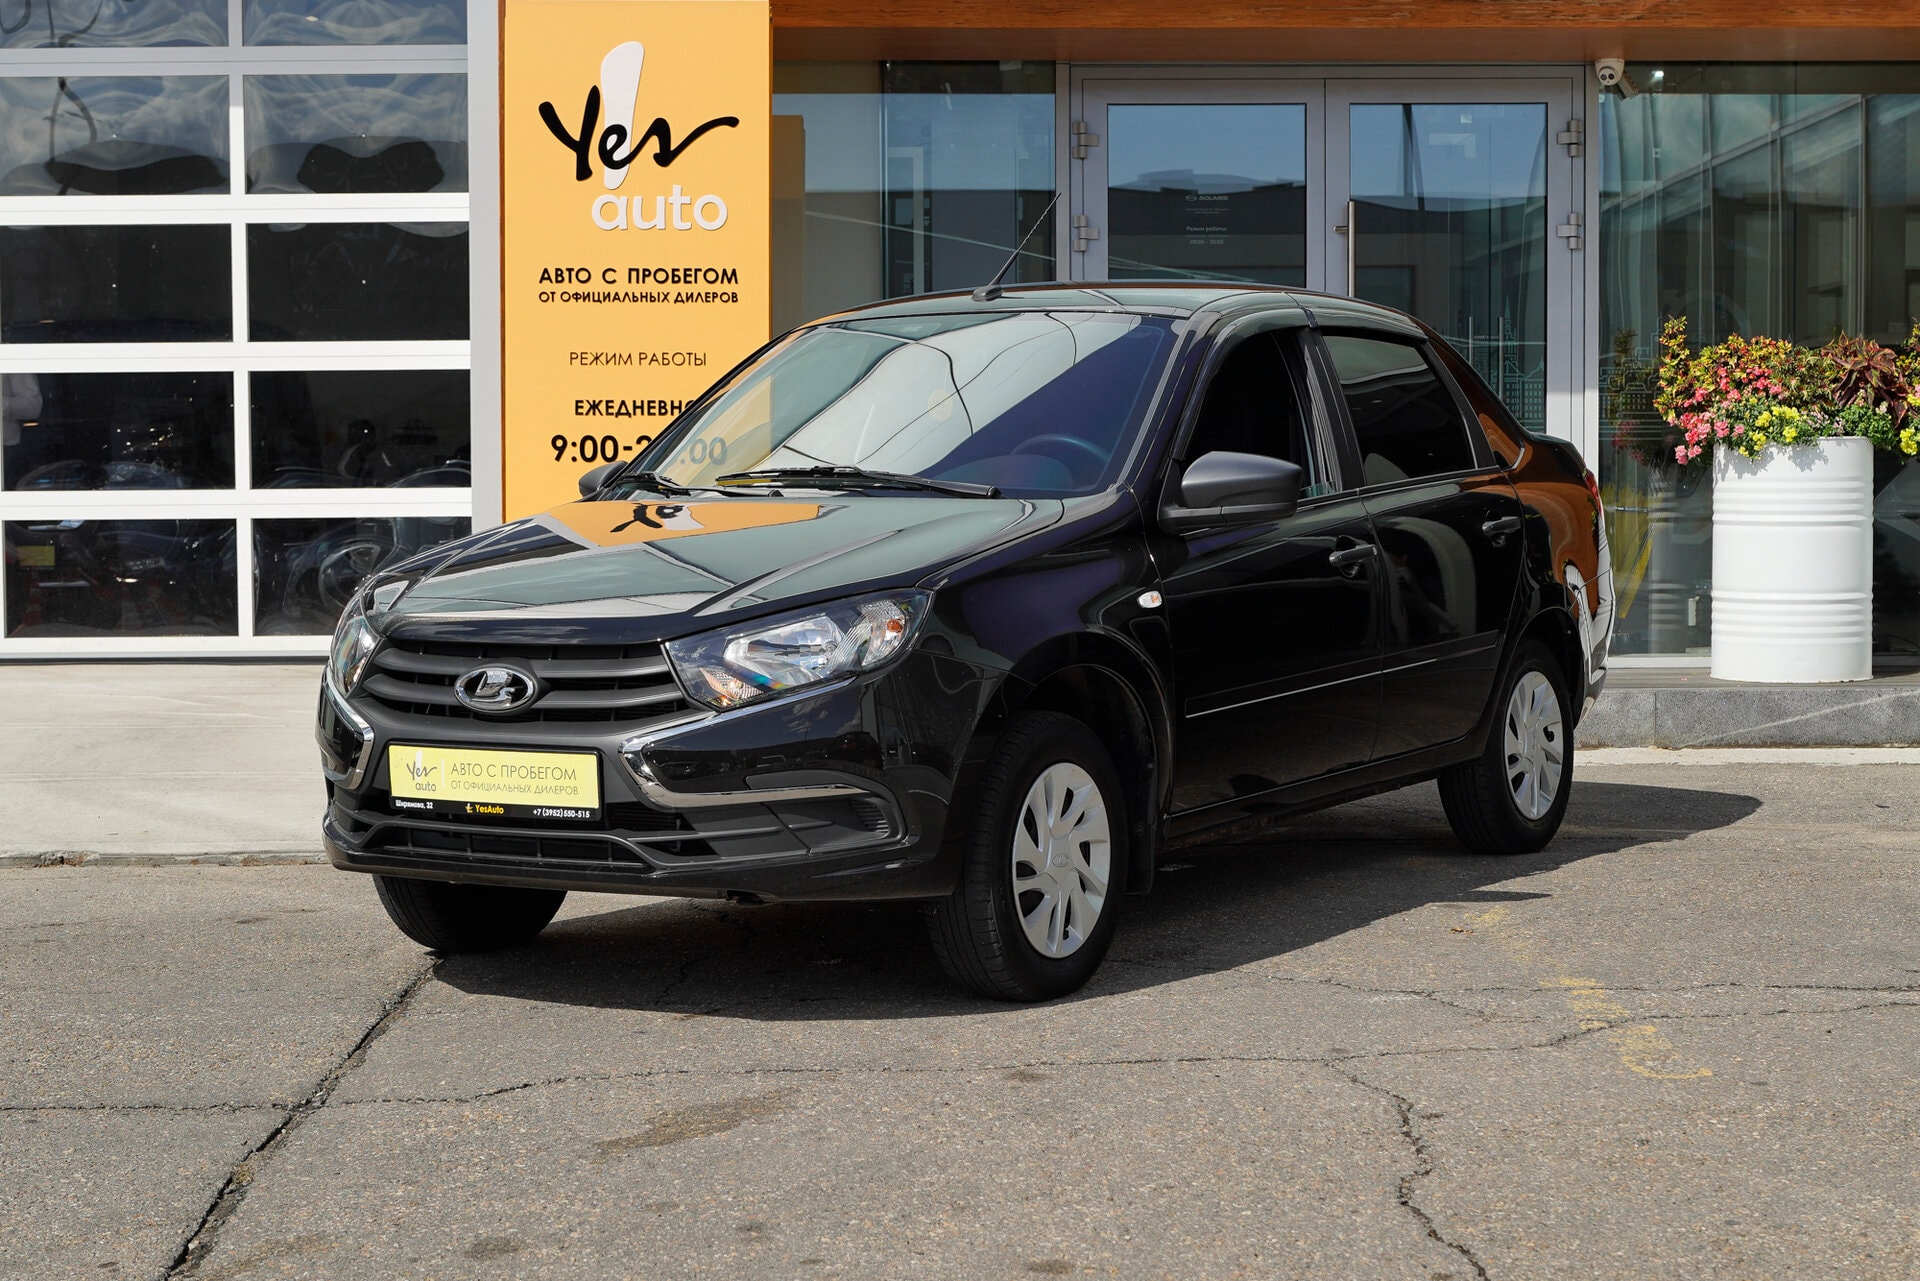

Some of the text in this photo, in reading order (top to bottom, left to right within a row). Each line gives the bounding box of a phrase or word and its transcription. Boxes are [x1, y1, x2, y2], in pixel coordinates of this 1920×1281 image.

[538, 85, 740, 182] Yes
[591, 184, 728, 231] auto
[539, 267, 739, 285] АВТО С ПРОБЕГОМ
[538, 291, 739, 304] ОТ ОФИЦИАЛЬНЫХ ДИЛЕРОВ
[569, 352, 707, 366] РЕЖИМ РАБОТЫ
[450, 763, 577, 781] АВТО С ПРОБЕГОМ
[415, 781, 437, 792] auto
[450, 780, 579, 796] ОТ ОФИЦИАЛЬНЫХ ДИЛЕРОВ
[475, 804, 505, 814] YesAuto
[533, 808, 541, 816] +7
